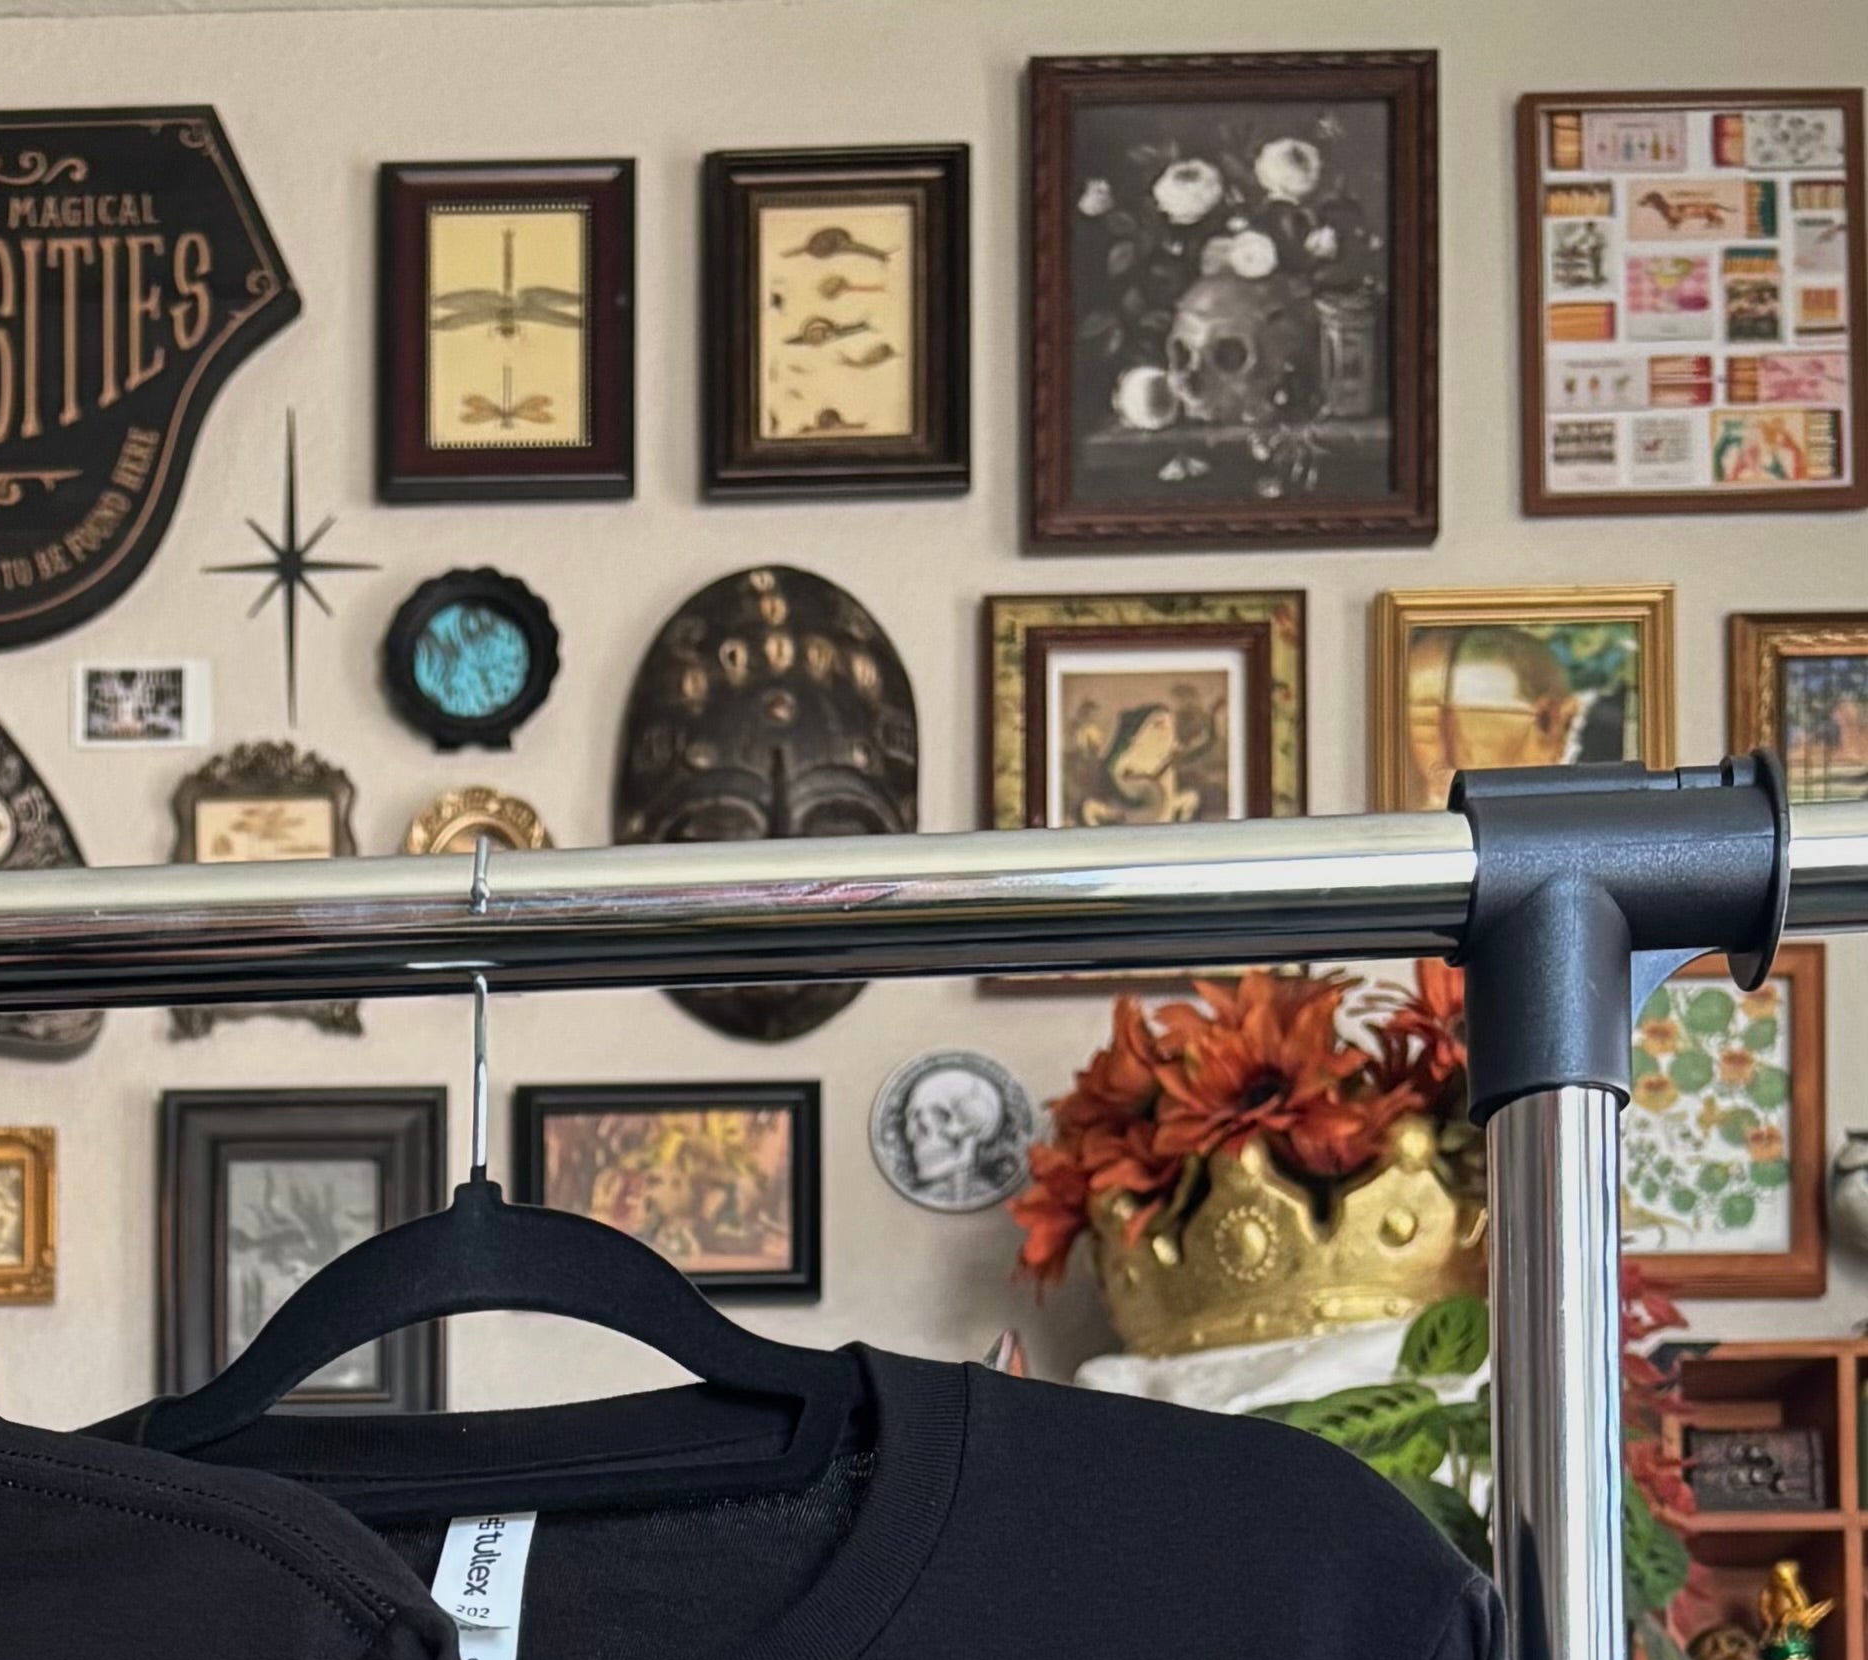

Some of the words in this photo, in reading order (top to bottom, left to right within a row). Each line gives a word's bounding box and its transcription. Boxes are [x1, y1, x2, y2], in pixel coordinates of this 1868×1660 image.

[8, 193, 162, 230] MAGICAL
[33, 545, 73, 581] BE
[463, 1529, 503, 1596] tultex
[456, 1603, 490, 1619] 202
